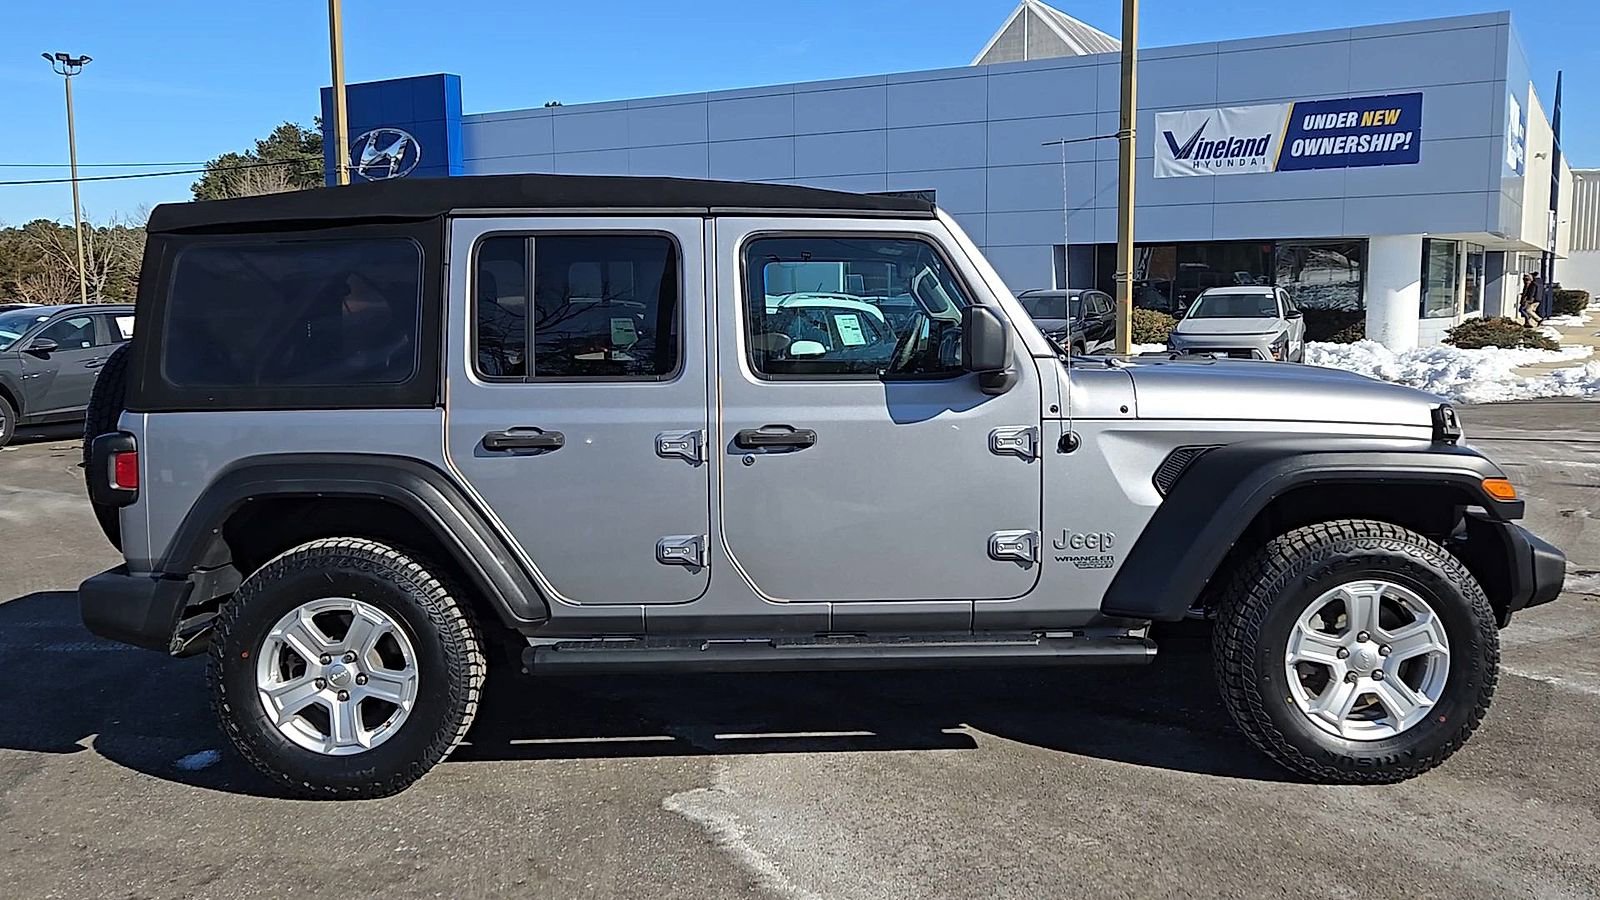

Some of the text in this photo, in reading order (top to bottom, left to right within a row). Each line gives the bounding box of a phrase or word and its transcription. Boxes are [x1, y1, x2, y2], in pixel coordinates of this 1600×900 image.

[1303, 109, 1401, 130] UNDER NEW
[1163, 117, 1272, 160] Vineland
[1290, 132, 1413, 157] OWNERSHIP!
[1193, 157, 1266, 168] HYUNDAI
[1052, 529, 1116, 553] Jeep
